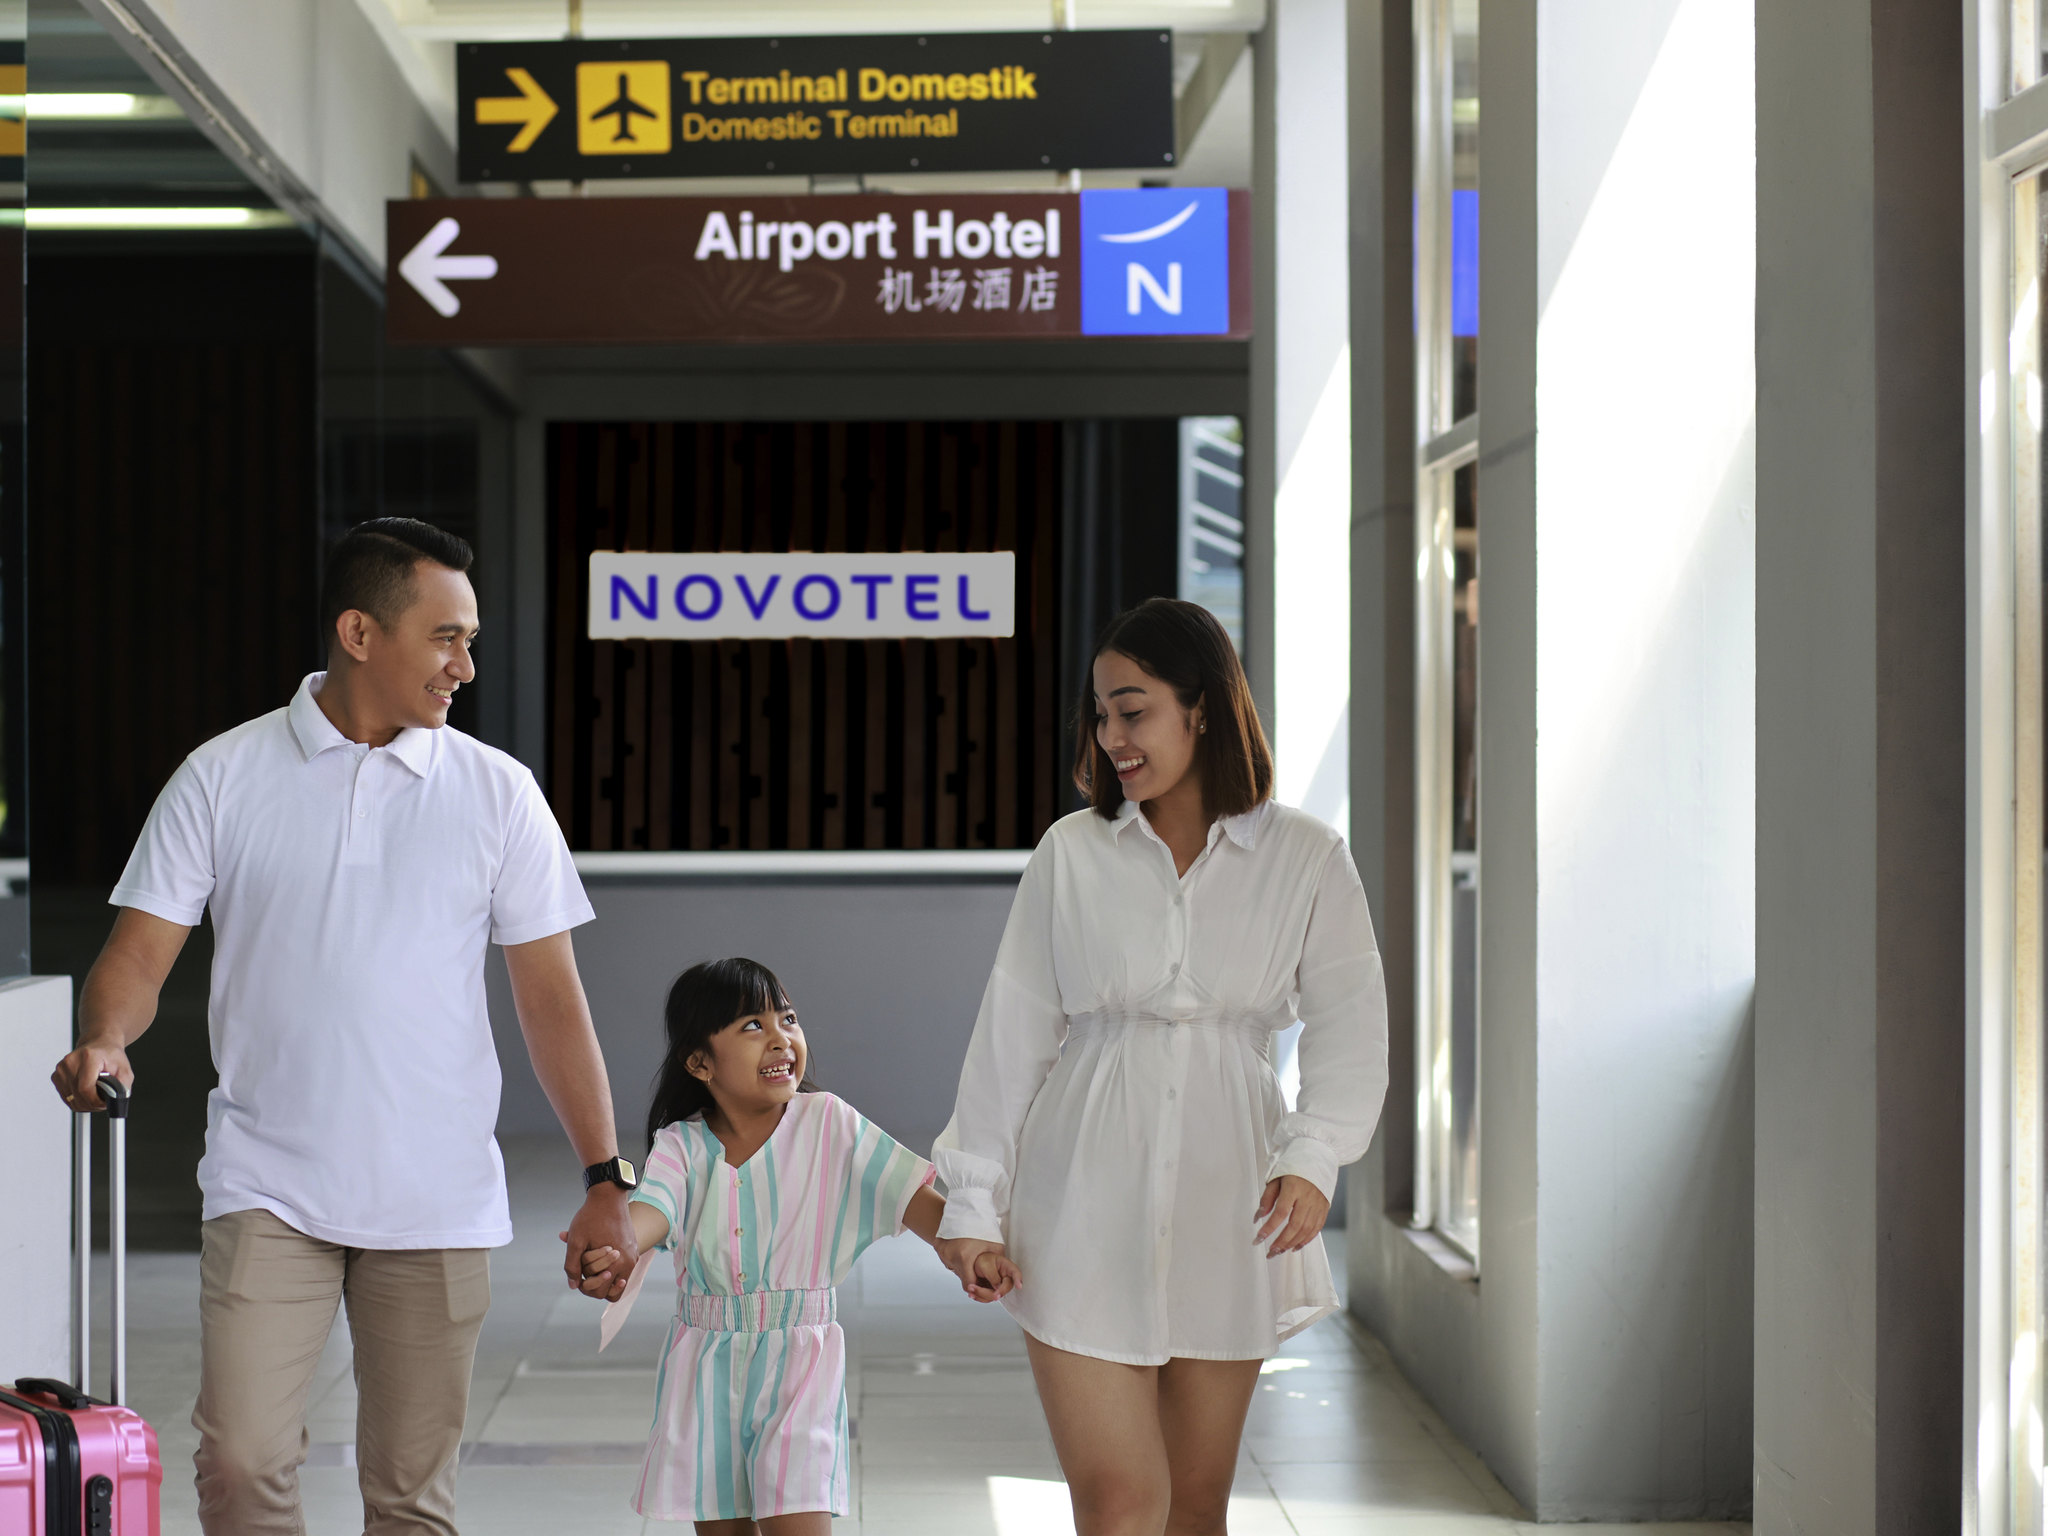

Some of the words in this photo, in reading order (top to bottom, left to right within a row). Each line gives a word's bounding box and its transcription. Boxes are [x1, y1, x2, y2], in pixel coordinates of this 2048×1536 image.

[682, 68, 848, 104] Terminal
[858, 65, 1037, 101] Domestik
[682, 111, 822, 141] Domestic
[826, 107, 958, 139] Terminal
[694, 211, 897, 272] Airport
[912, 209, 1060, 259] Hotel
[876, 266, 1060, 313] 机场酒店
[1127, 262, 1182, 315] N
[610, 574, 990, 621] NOVOTEL
